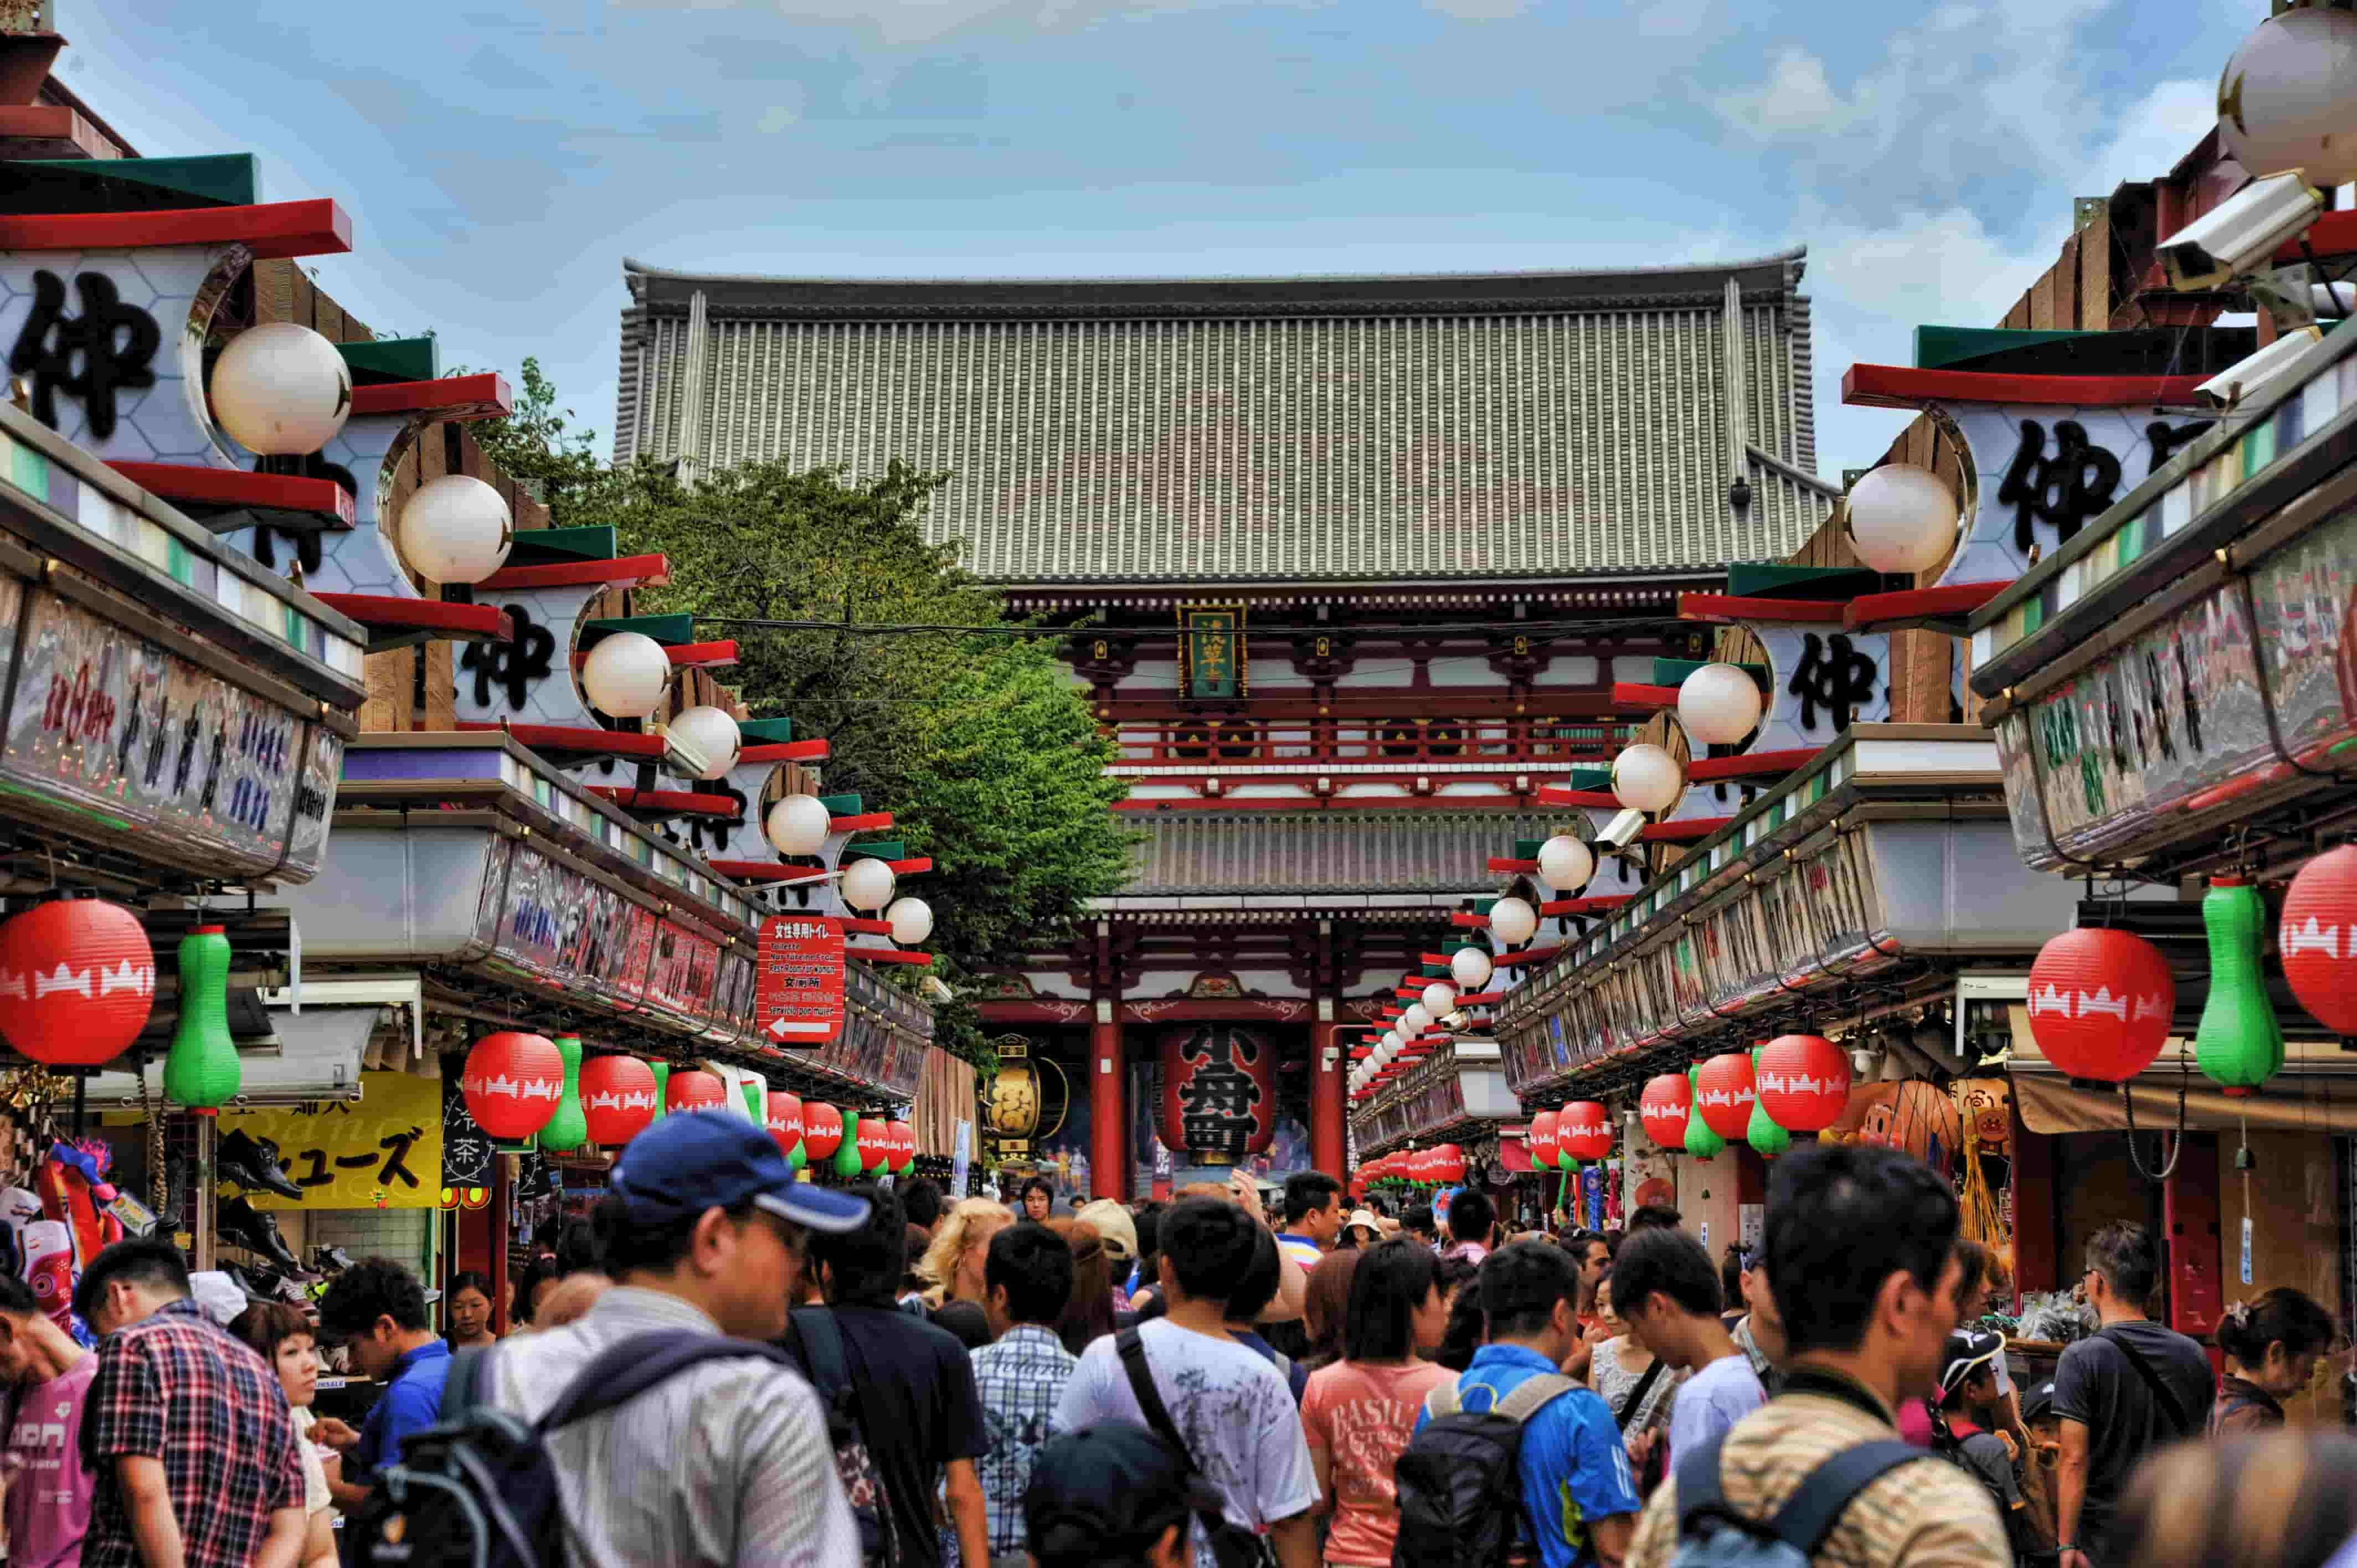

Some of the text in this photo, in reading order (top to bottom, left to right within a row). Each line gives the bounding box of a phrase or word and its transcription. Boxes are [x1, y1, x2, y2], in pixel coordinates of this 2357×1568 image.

[775, 922, 829, 939] 女性専用トイレ
